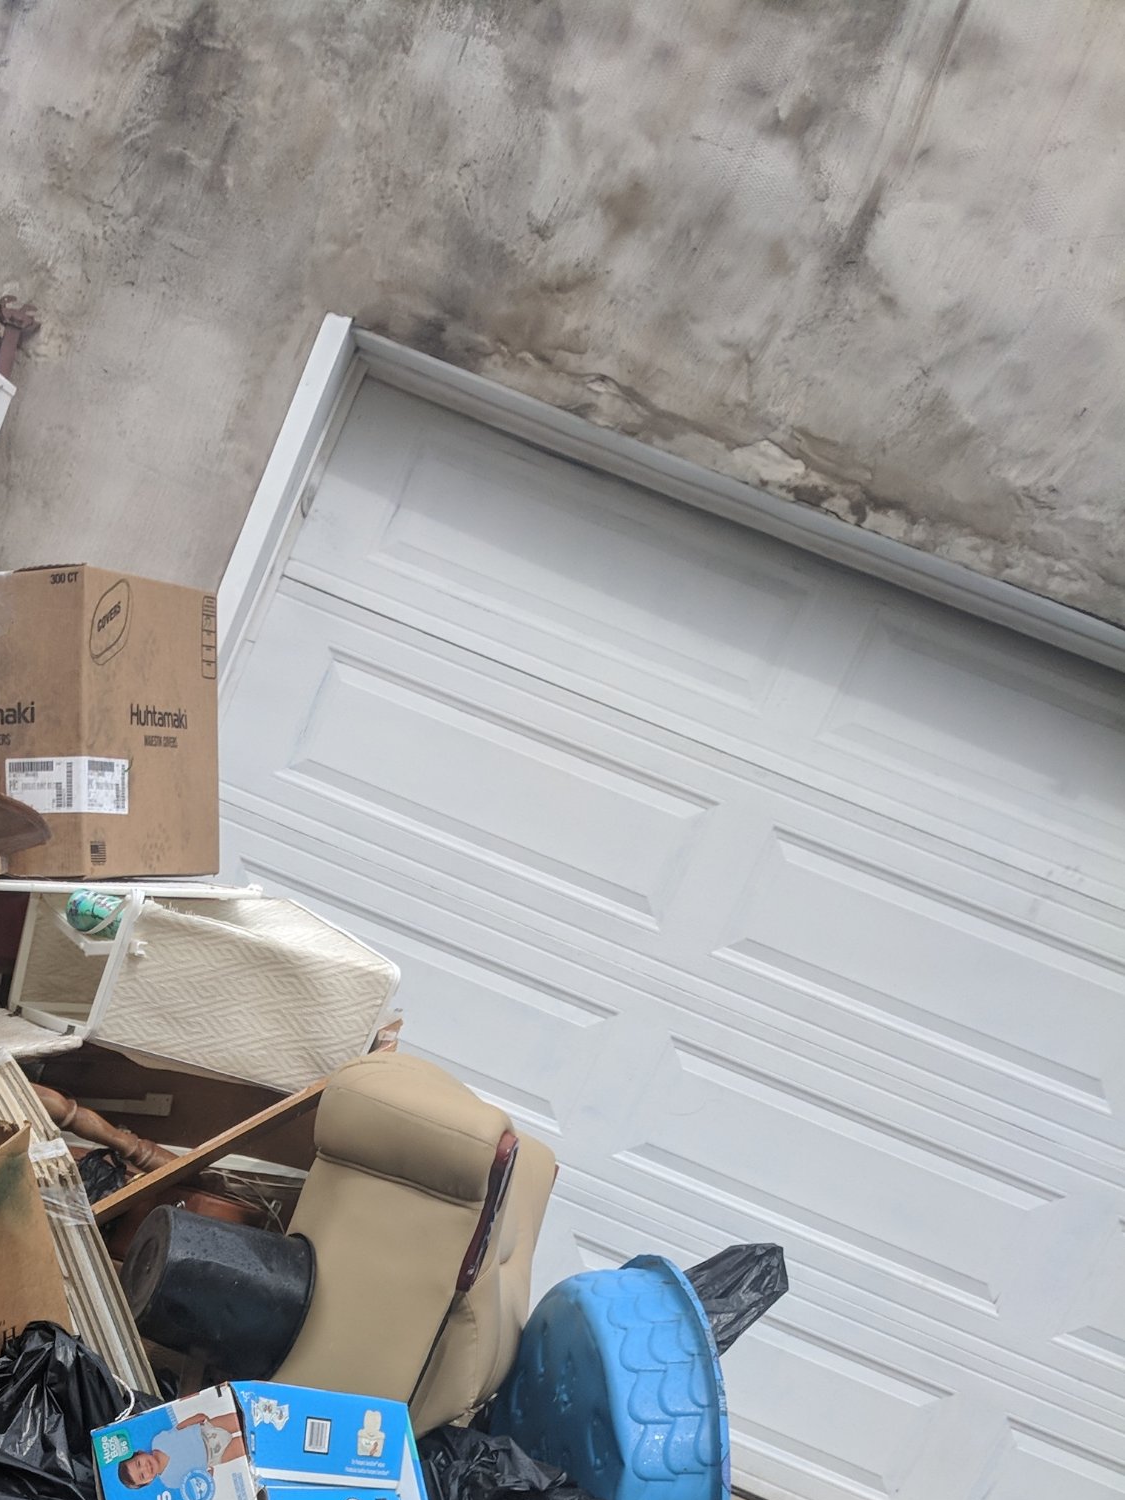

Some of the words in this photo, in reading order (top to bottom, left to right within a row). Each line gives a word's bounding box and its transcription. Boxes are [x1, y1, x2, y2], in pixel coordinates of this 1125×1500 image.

[50, 573, 66, 585] 300
[67, 571, 79, 583] CT
[96, 601, 122, 632] COVERS
[129, 703, 188, 730] Huhtamaki
[101, 1435, 114, 1464] Huge
[108, 1436, 119, 1460] Box
[121, 1440, 129, 1453] 96
